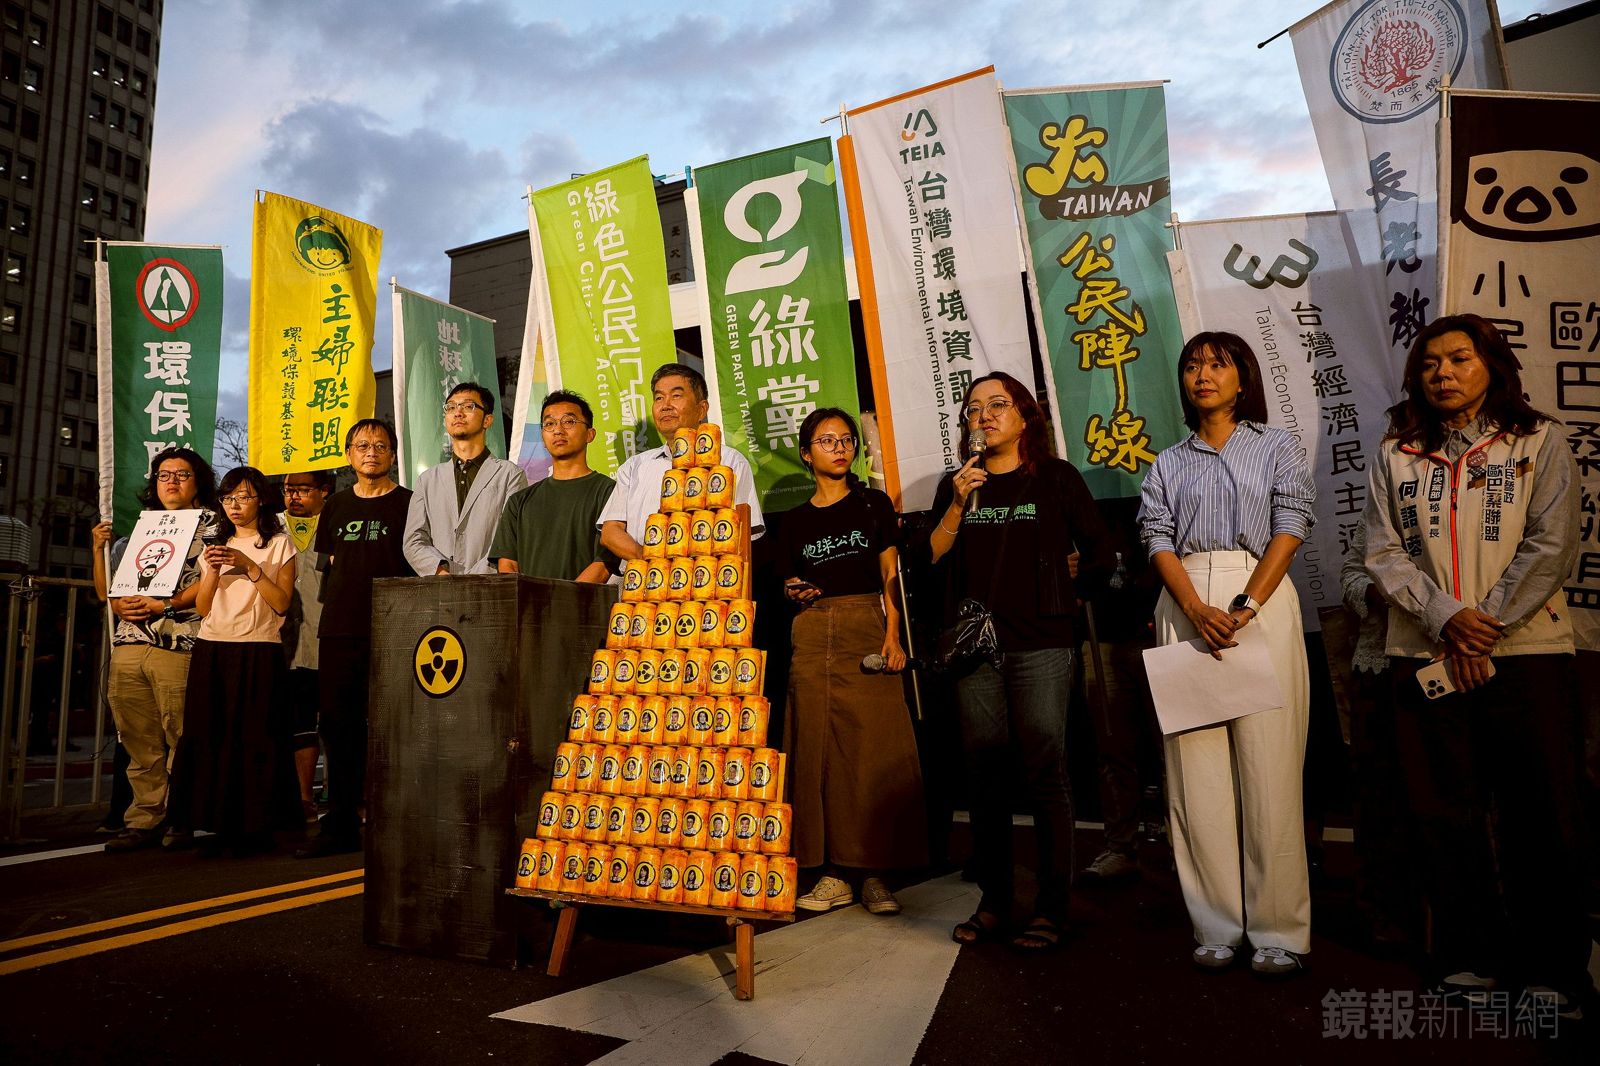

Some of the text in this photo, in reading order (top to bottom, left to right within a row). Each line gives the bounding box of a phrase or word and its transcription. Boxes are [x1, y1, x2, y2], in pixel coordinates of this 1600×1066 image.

[900, 141, 946, 165] TEIA
[1390, 80, 1419, 98] 1865
[1058, 185, 1153, 217] TAIWAN
[567, 190, 586, 252] Green
[596, 357, 612, 421] Action
[903, 175, 919, 224] Taiwan
[911, 228, 934, 325] Environmental
[925, 326, 947, 408] Information
[918, 170, 977, 442] 台灣環境資訊
[1060, 233, 1158, 472] 公民陣線
[1255, 306, 1280, 362] Taiwan
[281, 326, 303, 464] 環境保護基金會
[306, 284, 355, 463] 主婦聯盟
[726, 304, 760, 453] GREEN PARTY TAIWAN
[748, 293, 820, 451] 綠黨
[1428, 502, 1441, 539] 秘書長
[1484, 464, 1503, 542] 歐巴桑聯盟
[1304, 550, 1325, 602] Union
